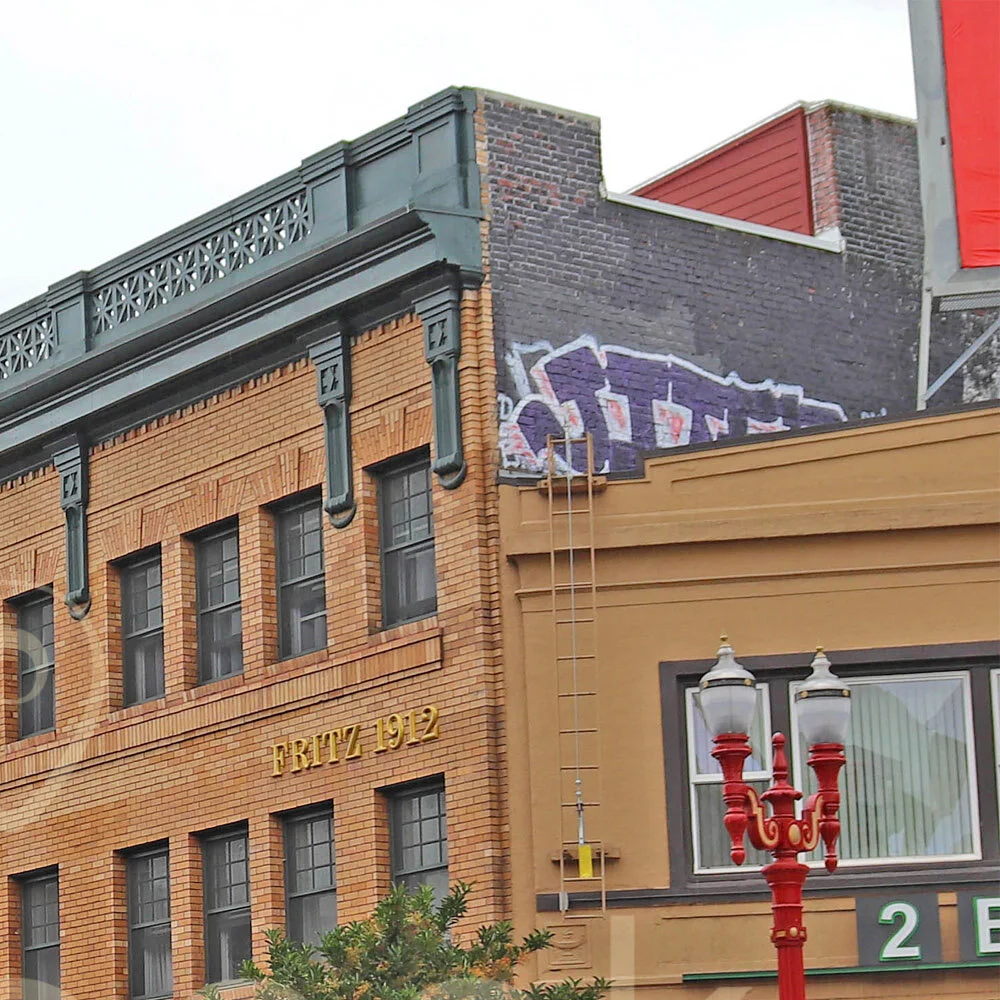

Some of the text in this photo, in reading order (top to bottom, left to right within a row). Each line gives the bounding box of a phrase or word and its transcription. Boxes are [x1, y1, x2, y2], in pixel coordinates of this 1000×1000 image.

[271, 705, 440, 777] FRITZ 1912
[878, 901, 921, 961] 2
